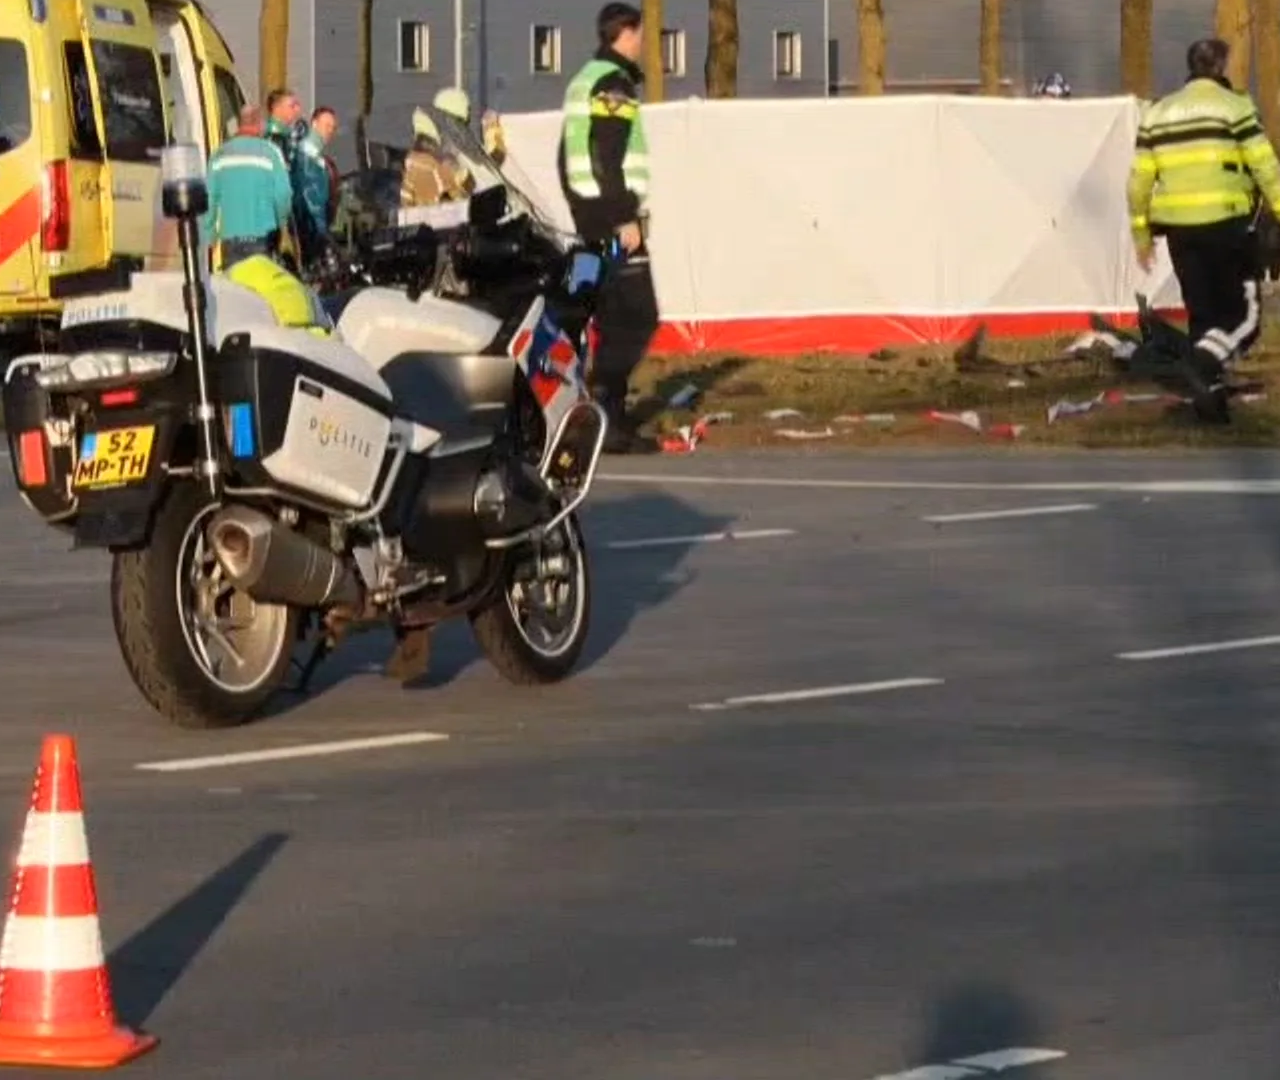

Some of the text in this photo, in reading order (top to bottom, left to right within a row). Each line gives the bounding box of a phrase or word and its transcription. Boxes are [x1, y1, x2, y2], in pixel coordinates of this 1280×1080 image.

[107, 431, 137, 454] 52
[308, 416, 374, 459] POLITIE
[77, 451, 146, 481] MP-TH
